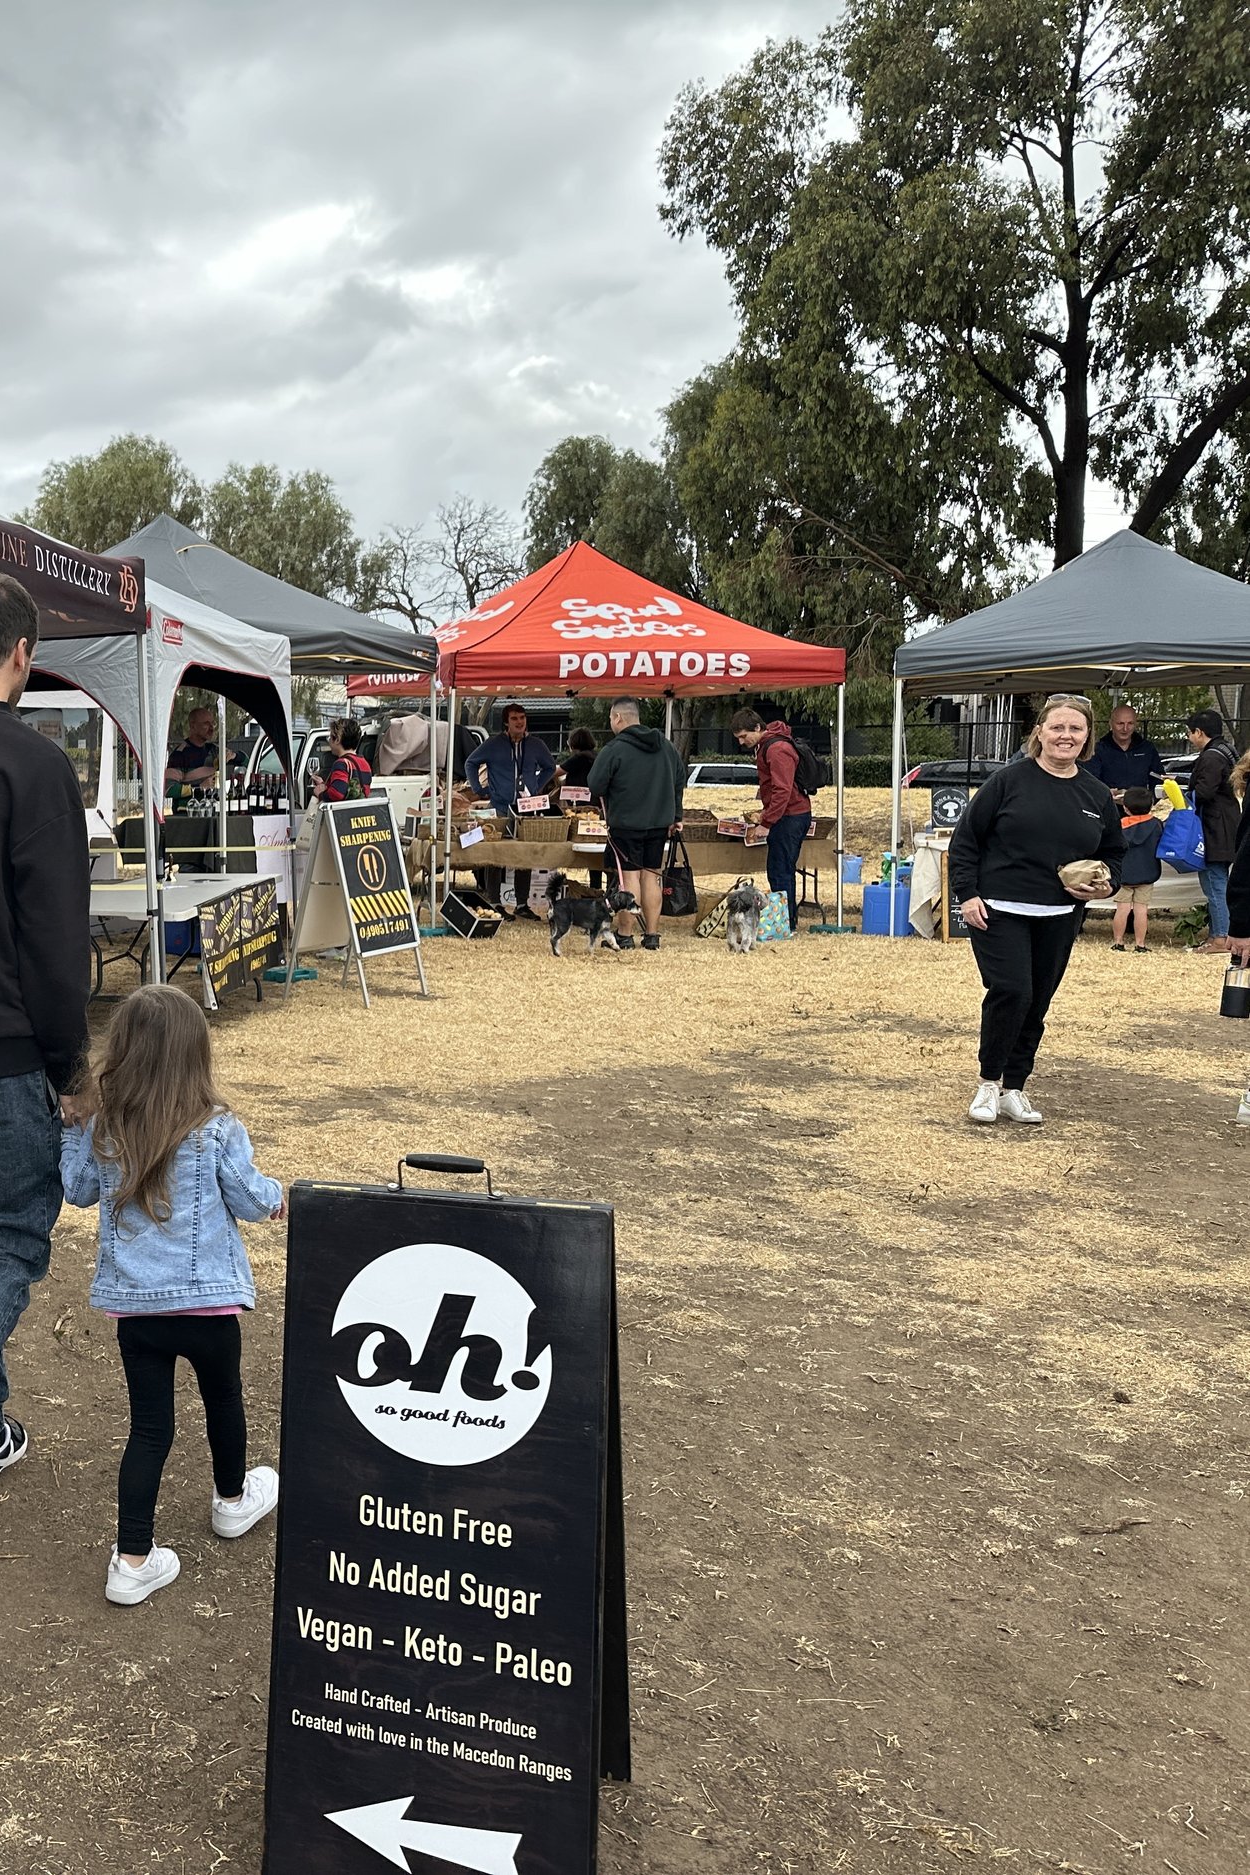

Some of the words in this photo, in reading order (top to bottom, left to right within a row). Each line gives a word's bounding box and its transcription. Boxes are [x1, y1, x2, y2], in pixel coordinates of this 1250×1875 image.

[34, 545, 111, 597] DISTILLERY
[551, 615, 707, 640] Sisters
[561, 596, 683, 620] Spud
[559, 651, 751, 679] POTATOES
[339, 829, 392, 847] SHARPENING
[350, 815, 377, 829] KNIFE
[359, 918, 410, 939] 0490517491
[331, 1293, 550, 1402] oh!
[375, 1404, 398, 1416] so
[400, 1407, 450, 1422] good
[452, 1410, 506, 1430] foods
[359, 1494, 443, 1538] Gluten
[453, 1508, 513, 1548] Free
[329, 1550, 360, 1586] No
[368, 1558, 450, 1601] Added
[459, 1572, 542, 1620] Sugar
[297, 1606, 373, 1653] Vegan
[404, 1625, 463, 1667] Keto
[495, 1641, 572, 1687] Paleo
[325, 1682, 358, 1705] Hand
[361, 1690, 411, 1715] Crafted
[425, 1702, 476, 1728] Artisan
[479, 1712, 537, 1740] Produce
[291, 1708, 342, 1735] Created
[346, 1721, 375, 1742] with
[378, 1726, 406, 1748] love
[410, 1732, 423, 1751] in
[426, 1736, 449, 1756] the
[452, 1740, 515, 1770] Macedon
[519, 1754, 572, 1782] Ranges
